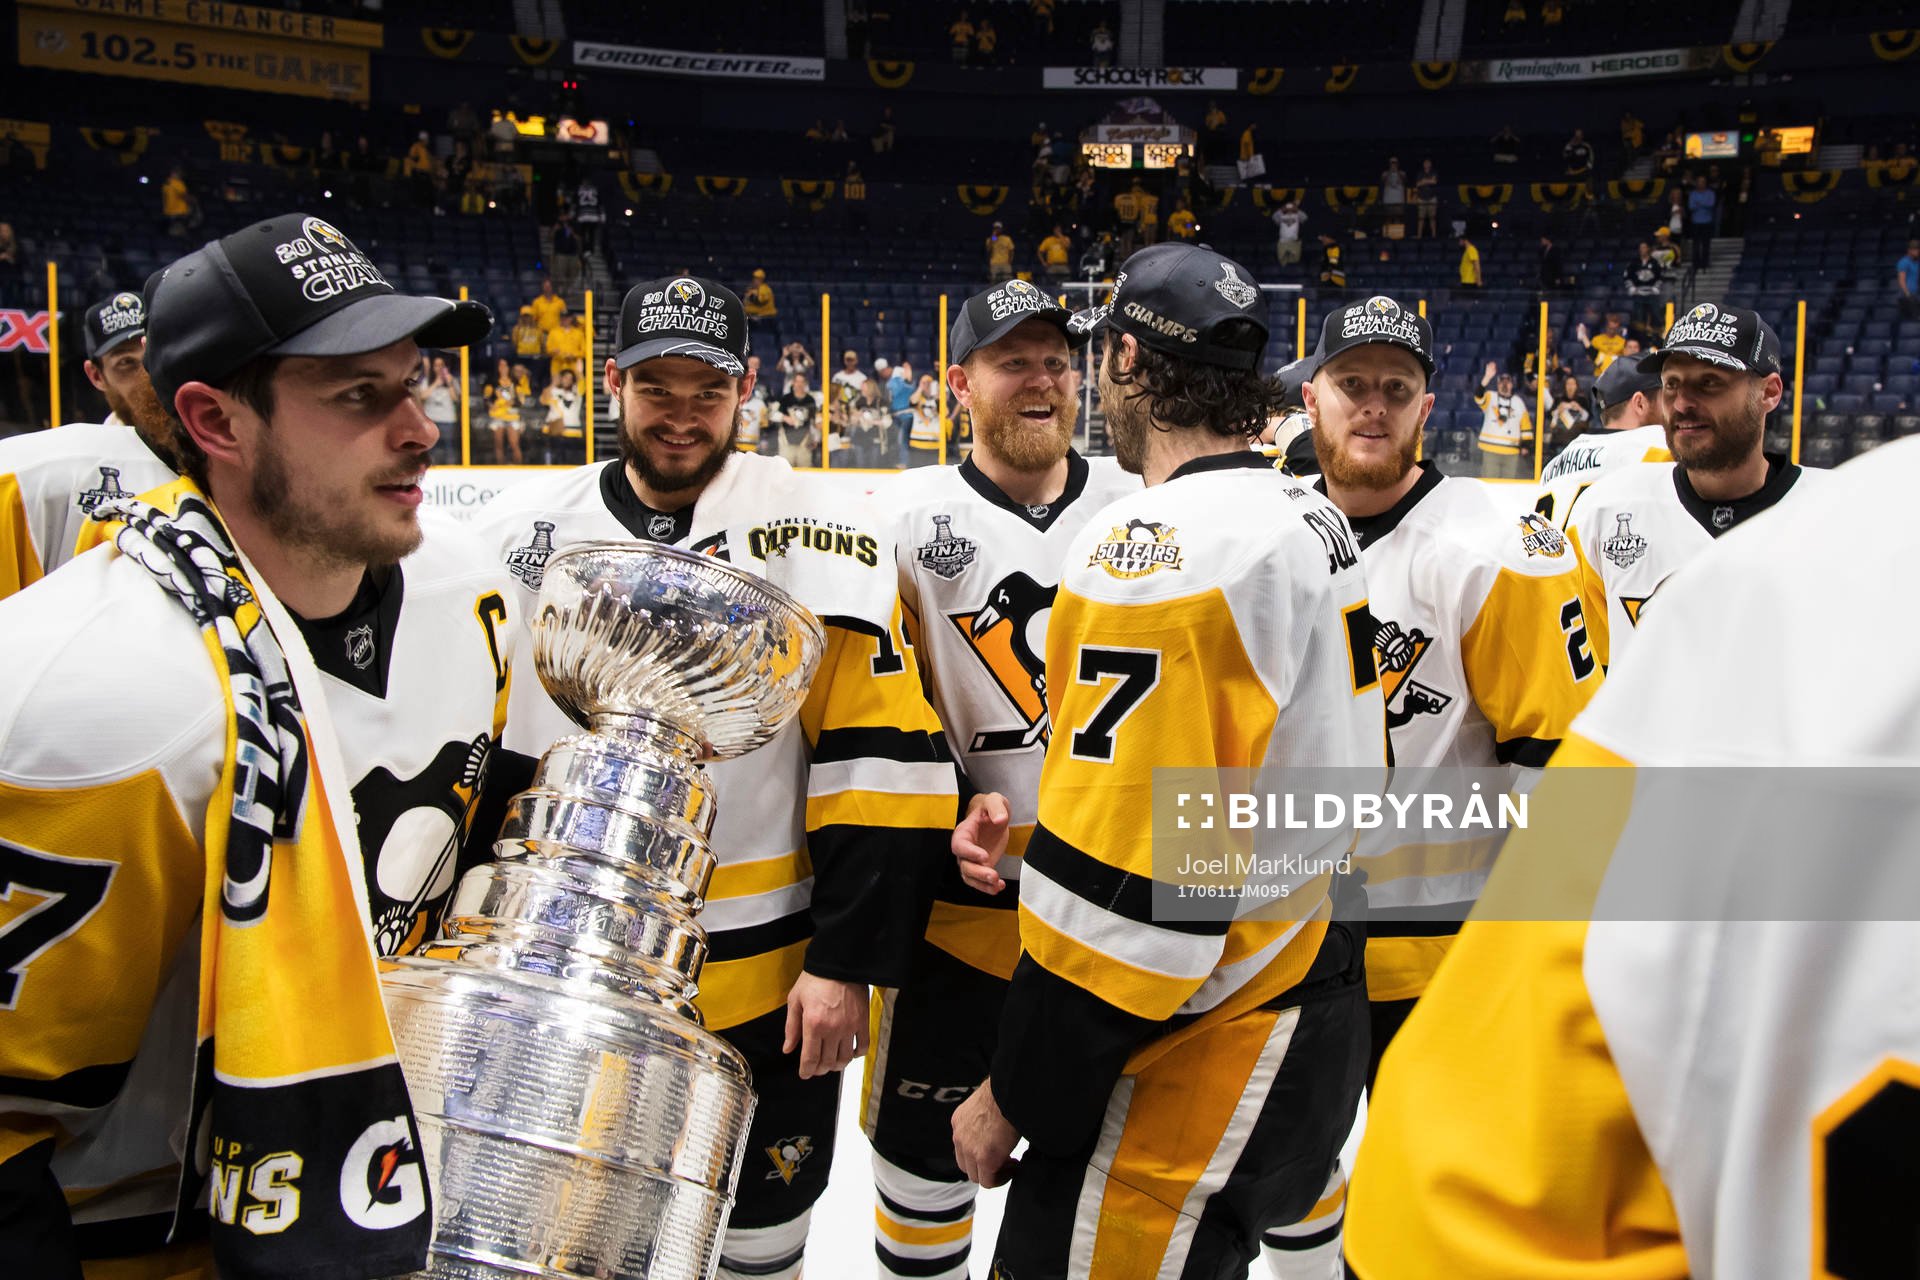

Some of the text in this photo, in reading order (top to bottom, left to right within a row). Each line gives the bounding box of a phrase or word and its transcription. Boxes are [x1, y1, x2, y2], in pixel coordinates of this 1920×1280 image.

[186, 1, 336, 38] CHANGER
[80, 32, 363, 87] 102.5 THE GAME
[1497, 54, 1680, 81] Remington HEROES
[1074, 68, 1140, 85] SCHOOL
[1156, 69, 1204, 85] ROCK
[275, 238, 312, 264] 20
[642, 291, 725, 310] 20 17
[640, 305, 727, 322] STANLEY CUP
[1124, 301, 1199, 343] CHAMPS
[1344, 314, 1420, 333] STANLEY CUP
[637, 313, 729, 340] CHAMPS
[1341, 321, 1421, 347] CHAMPS
[1714, 323, 1738, 334] CUP
[651, 520, 671, 534] NHL
[827, 522, 853, 531] CUP
[919, 543, 974, 558] FINAL
[1096, 541, 1177, 563] 50 YEARS
[1526, 537, 1539, 550] 50
[1604, 538, 1647, 552] FINAL
[353, 635, 370, 662] NHL
[1070, 643, 1163, 766] 7
[897, 1079, 982, 1103] CC
[339, 1115, 427, 1231] G
